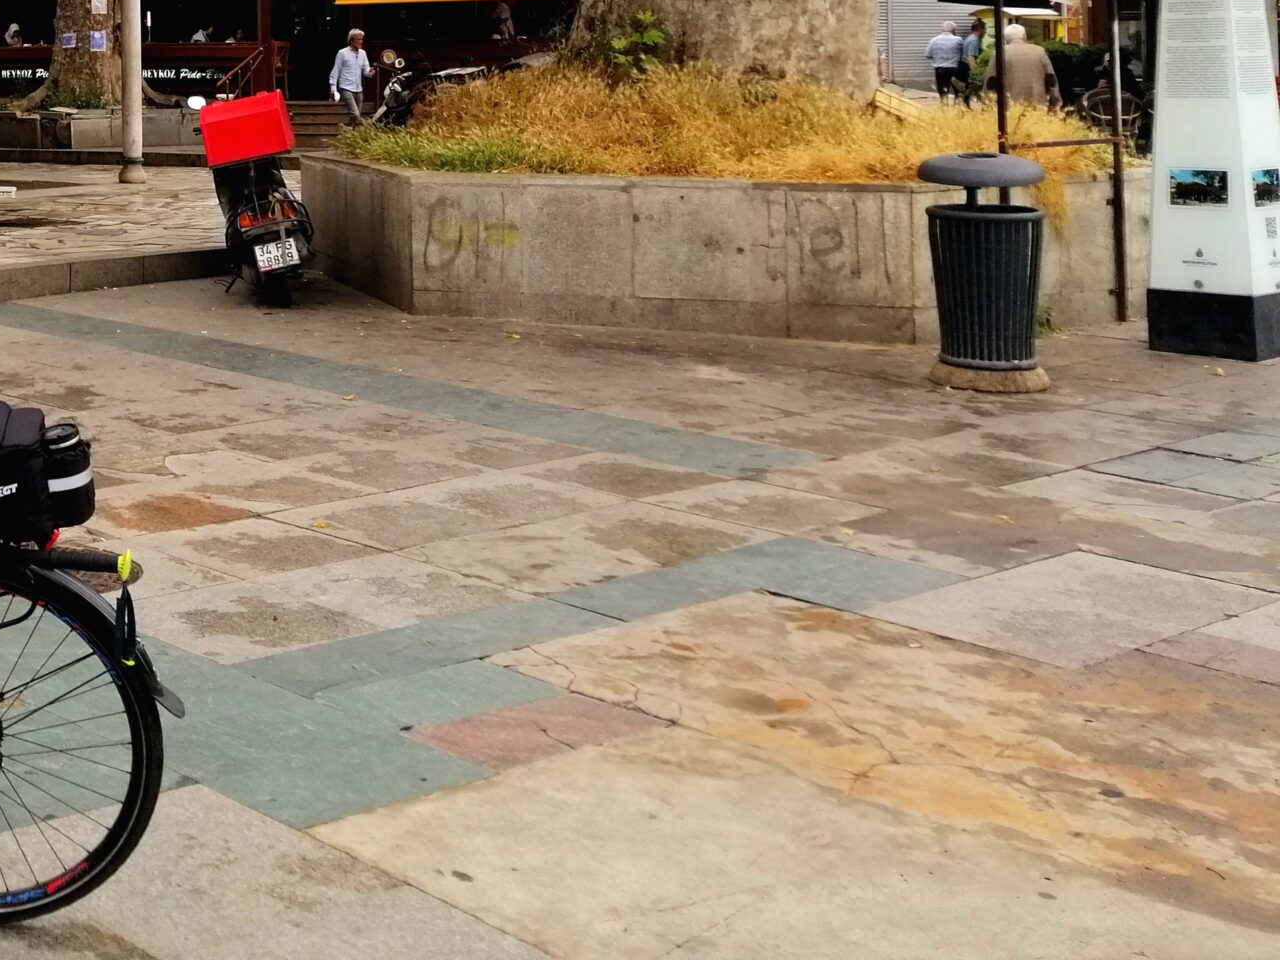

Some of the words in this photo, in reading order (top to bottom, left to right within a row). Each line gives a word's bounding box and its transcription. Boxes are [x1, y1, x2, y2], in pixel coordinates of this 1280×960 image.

[1, 69, 33, 79] BEYKOZ
[141, 68, 177, 79] BEYKOZ
[259, 245, 272, 257] 34
